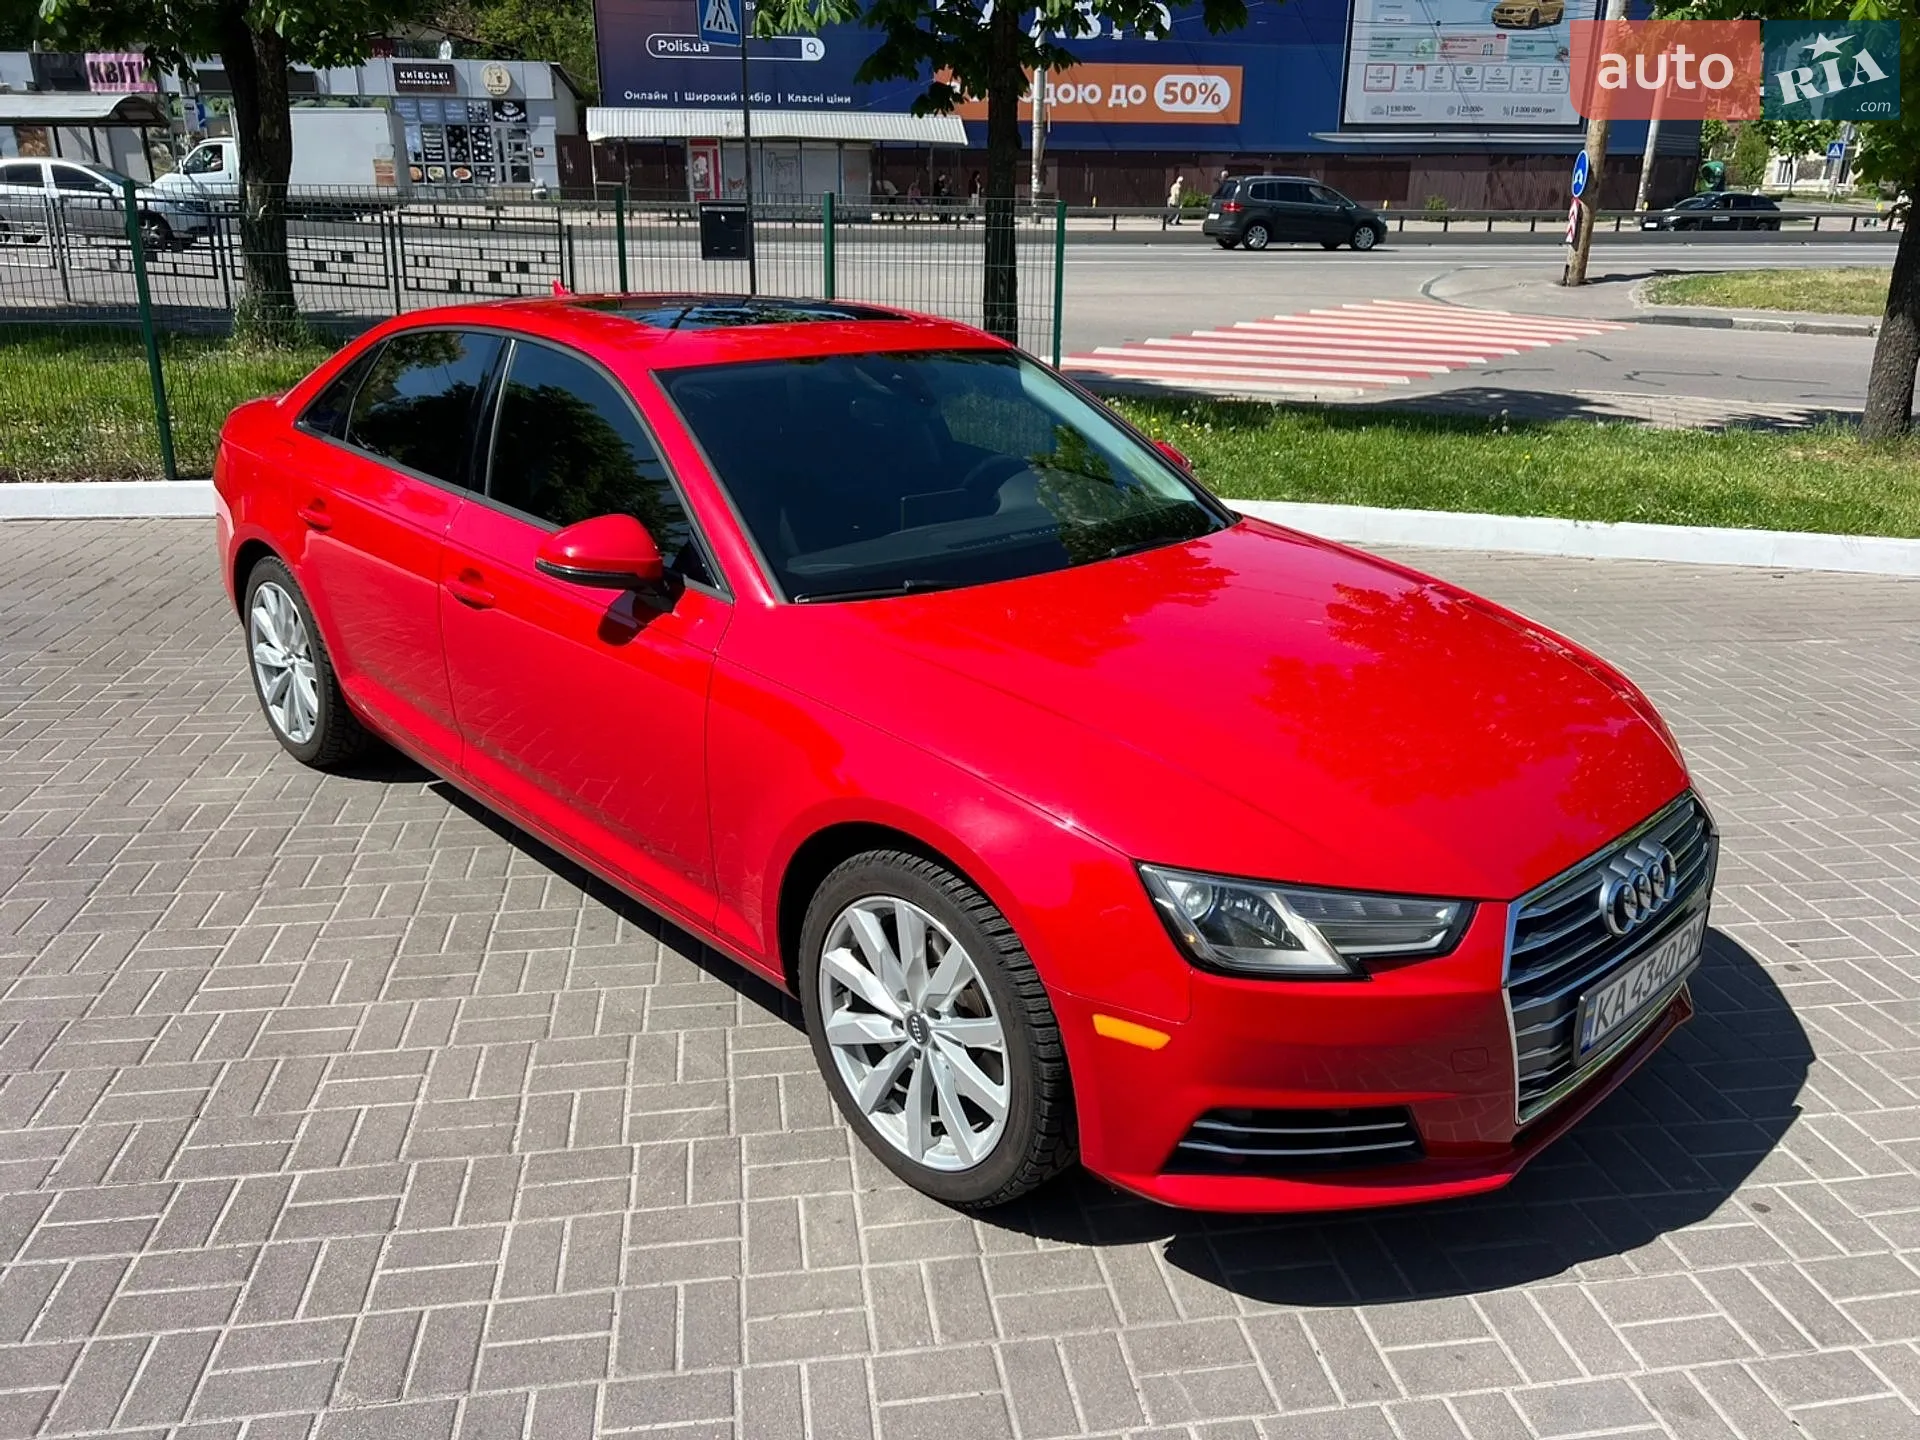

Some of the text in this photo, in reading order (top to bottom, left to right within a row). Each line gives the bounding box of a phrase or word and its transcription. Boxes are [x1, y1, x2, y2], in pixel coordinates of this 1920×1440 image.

[657, 39, 710, 53] Polis.ua
[89, 60, 144, 84] КВІТ
[400, 70, 448, 79] КИЇВСЬКІ
[624, 90, 668, 101] Онлайн
[684, 91, 738, 104] Широкий
[787, 93, 824, 104] Класні
[826, 94, 851, 105] ціни
[1162, 82, 1221, 106] 50%
[1594, 979, 1627, 1037] KA
[1631, 941, 1677, 1004] 4340
